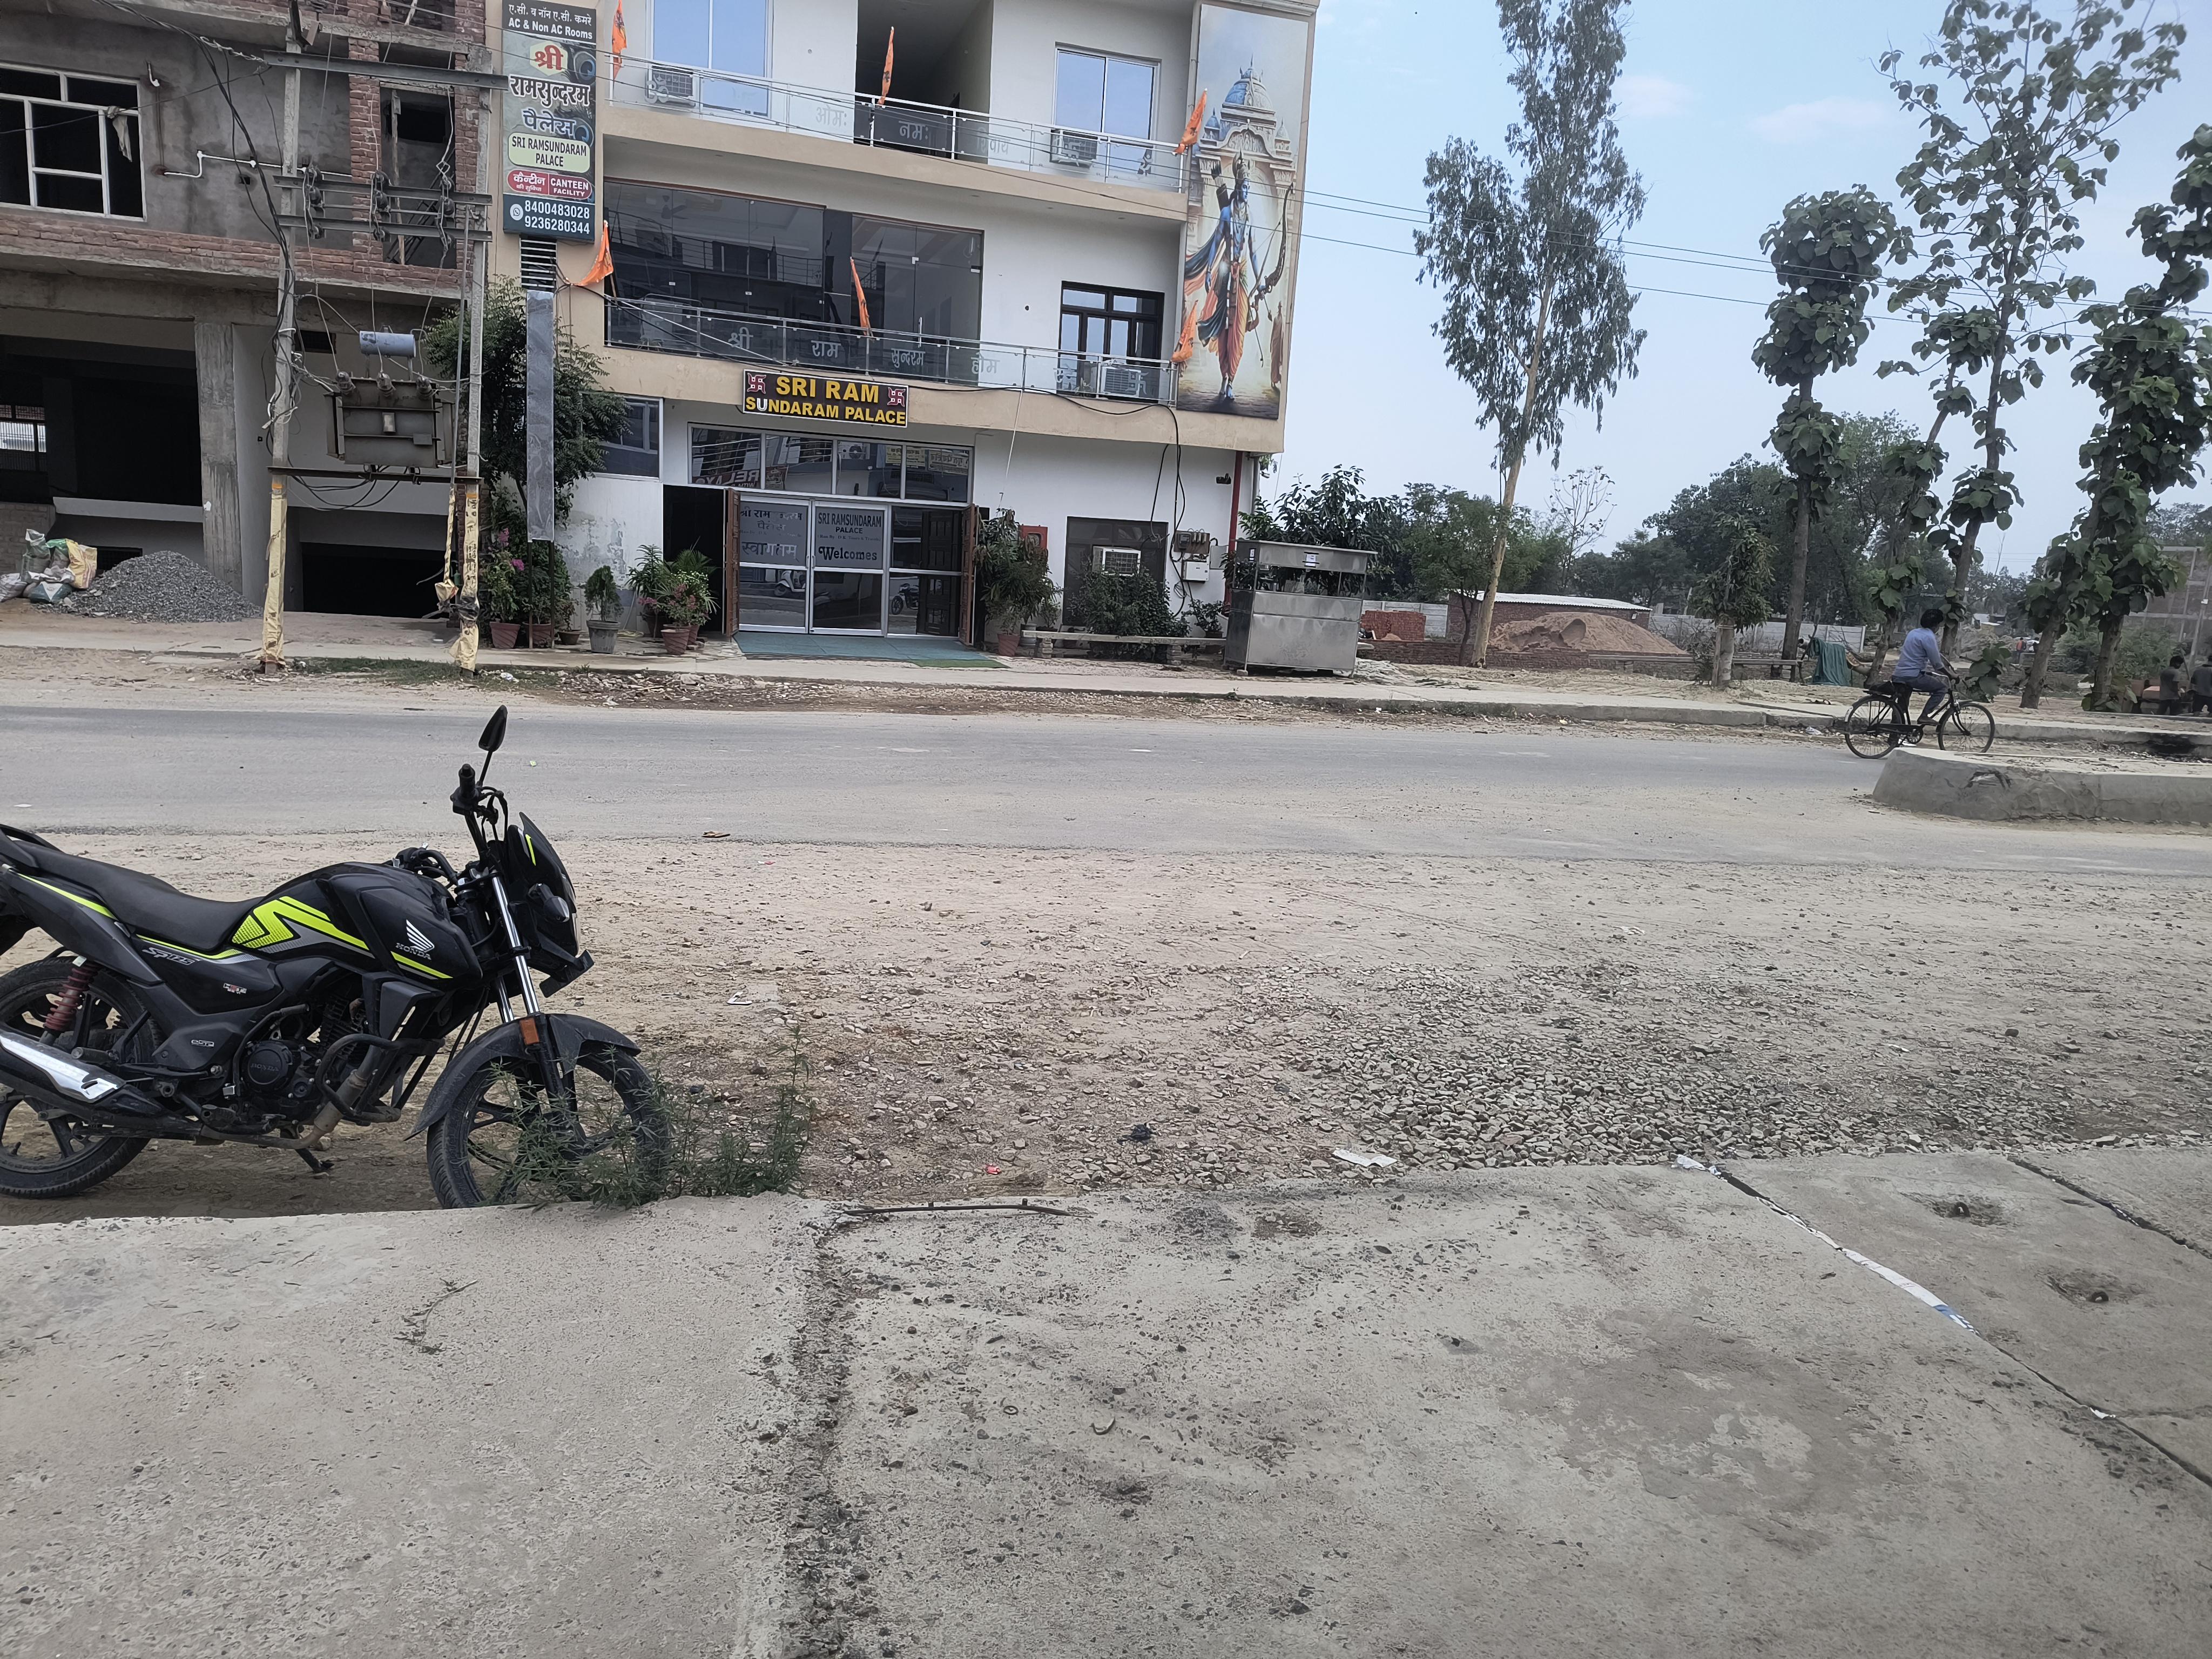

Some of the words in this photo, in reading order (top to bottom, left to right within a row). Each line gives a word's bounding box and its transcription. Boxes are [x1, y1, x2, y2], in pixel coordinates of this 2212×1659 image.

[509, 3, 528, 15] ए.सी.
[531, 8, 536, 16] व
[538, 6, 551, 19] नॉन
[553, 10, 571, 22] ए.सी.
[574, 14, 592, 26] कमरे
[509, 18, 521, 28] AC
[523, 20, 530, 29] &
[532, 21, 549, 32] Non
[551, 24, 562, 35] AC
[565, 26, 592, 39] Rooms
[535, 45, 564, 70] श्री
[509, 74, 590, 108] रामसुन्दरम
[522, 108, 576, 136] पैलेस
[512, 136, 525, 148] SRI
[528, 138, 586, 157] RAMSUNDARAM
[536, 153, 564, 167] PALACE
[550, 178, 589, 191] CANTEEN
[554, 188, 585, 197] FACILITY
[525, 200, 590, 219] 8400483028
[524, 215, 590, 234] 9236280344
[729, 327, 753, 349] श्री
[811, 340, 841, 358] राम
[891, 348, 926, 368] सुन्दरम
[971, 352, 1000, 374] होम
[776, 376, 816, 397] SRI
[826, 380, 879, 403] RAM
[746, 396, 839, 419] SUNDARAM
[845, 407, 906, 424] PALACE
[818, 512, 830, 524] SRI
[832, 513, 881, 527] RAMSUNDARAM
[819, 547, 877, 561] Welcomes
[395, 942, 431, 960] HONDA
[250, 1063, 279, 1072] HONDA
